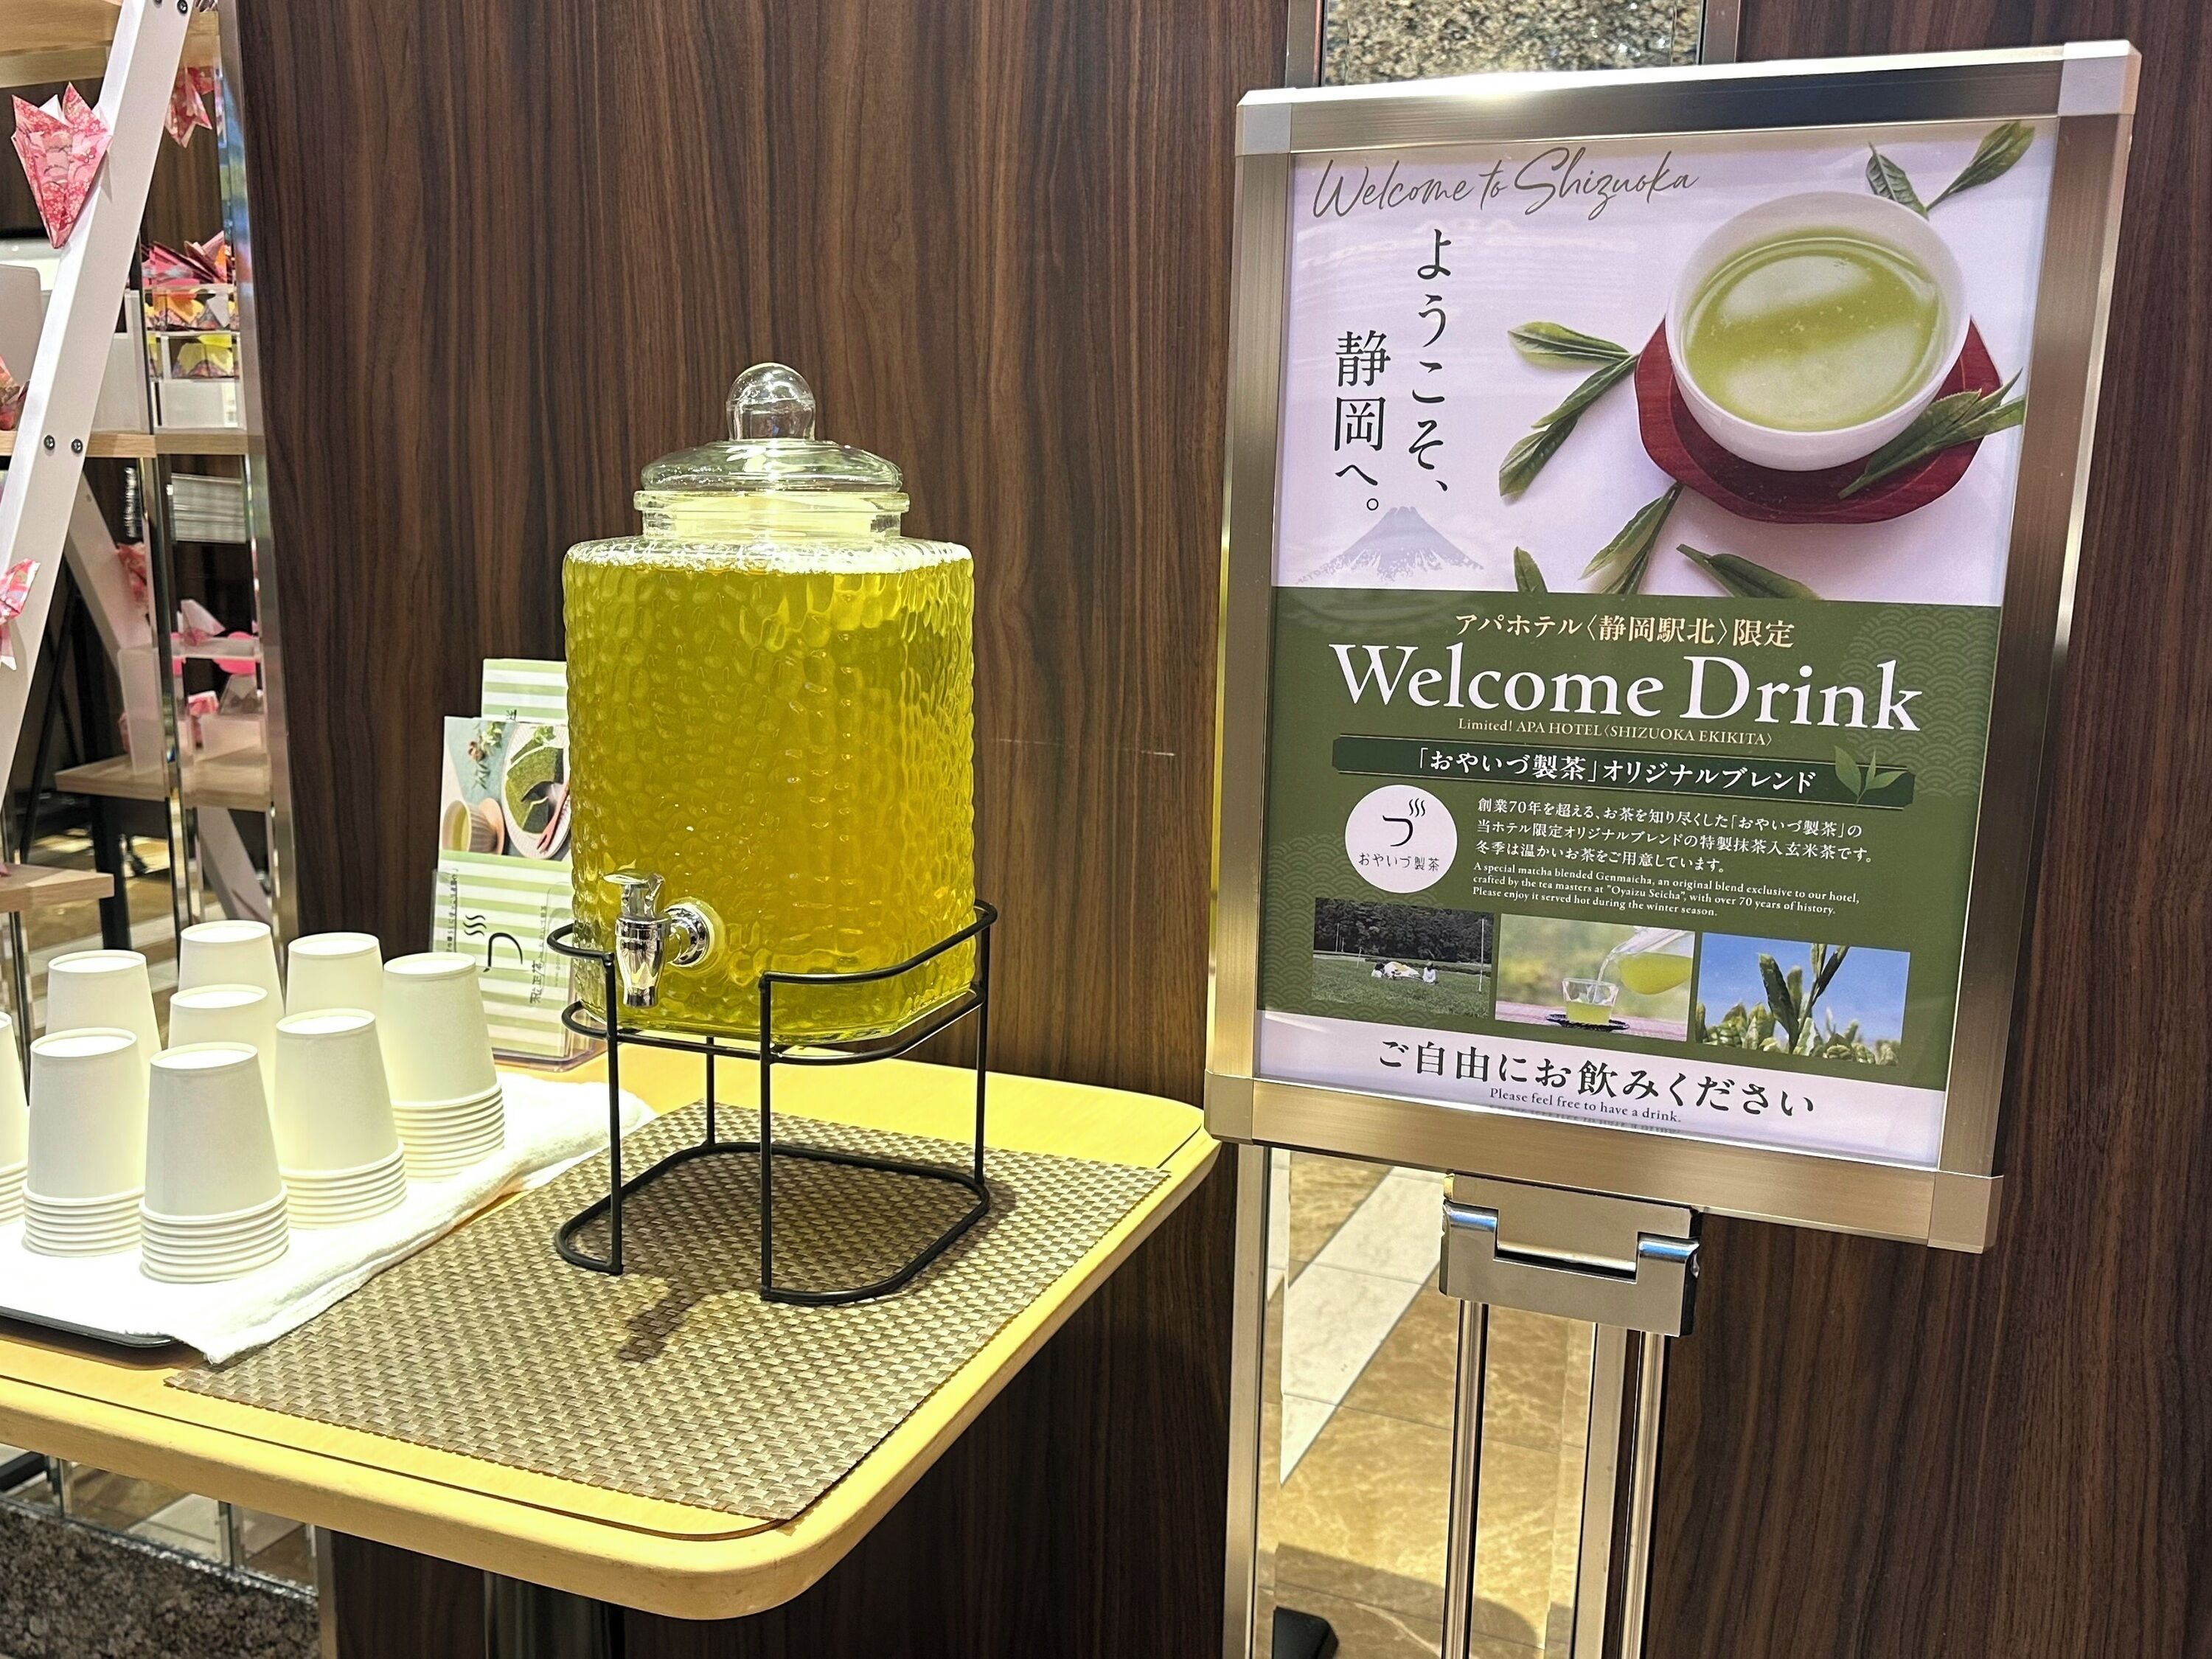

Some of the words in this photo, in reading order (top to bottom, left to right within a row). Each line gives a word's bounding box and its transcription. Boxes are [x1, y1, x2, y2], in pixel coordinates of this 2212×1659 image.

[1313, 159, 1474, 218] Welcome
[1478, 159, 1511, 210] to
[1514, 147, 1700, 220] Shizuoka
[1408, 229, 1452, 492] ようこそ、
[1335, 330, 1391, 511] 静岡へ。
[1329, 641, 1663, 718] Welcome
[1680, 655, 1921, 731] Drink
[1458, 718, 1513, 732] Limited!
[1516, 722, 1545, 734] APA
[1358, 852, 1440, 872] おやいづ製茶
[1473, 862, 1482, 871] A
[1484, 864, 1516, 874] special
[1518, 866, 1552, 877] matcha
[1555, 868, 1593, 880] blended
[1596, 872, 1655, 886] Genmaicha,
[1658, 878, 1670, 887] an
[1672, 880, 1713, 891] original
[1715, 880, 1744, 893] blend
[1746, 883, 1792, 897] exclusive
[1795, 889, 1806, 899] to
[1808, 891, 1827, 900] our
[1829, 889, 1860, 905] hotel,
[1472, 886, 1501, 897] Please
[1503, 889, 1530, 902] enjoy
[1531, 891, 1539, 900] it
[1541, 891, 1572, 904] served
[1573, 894, 1590, 905] hot
[1593, 897, 1626, 911] during
[1628, 900, 1644, 910] the
[1646, 902, 1679, 914] winter
[1680, 905, 1718, 917] season.
[1473, 874, 1506, 886] crafted
[1508, 877, 1519, 888] by
[1521, 877, 1537, 888] the
[1539, 880, 1553, 889] tea
[1555, 882, 1592, 893] masters
[1594, 885, 1604, 894] at
[1689, 893, 1712, 903] with
[1714, 897, 1736, 905] over
[1739, 897, 1753, 906] 70
[1755, 900, 1781, 910] years
[1783, 900, 1796, 911] of
[1797, 901, 1836, 917] history.
[1379, 1040, 1814, 1117] ご自由にお飲みください
[1490, 1088, 1528, 1103] Please
[1531, 1093, 1553, 1105] feel
[1557, 1096, 1580, 1109] free
[1584, 1102, 1596, 1111] to
[1600, 1102, 1629, 1116] have
[1642, 1106, 1682, 1123] drink.
